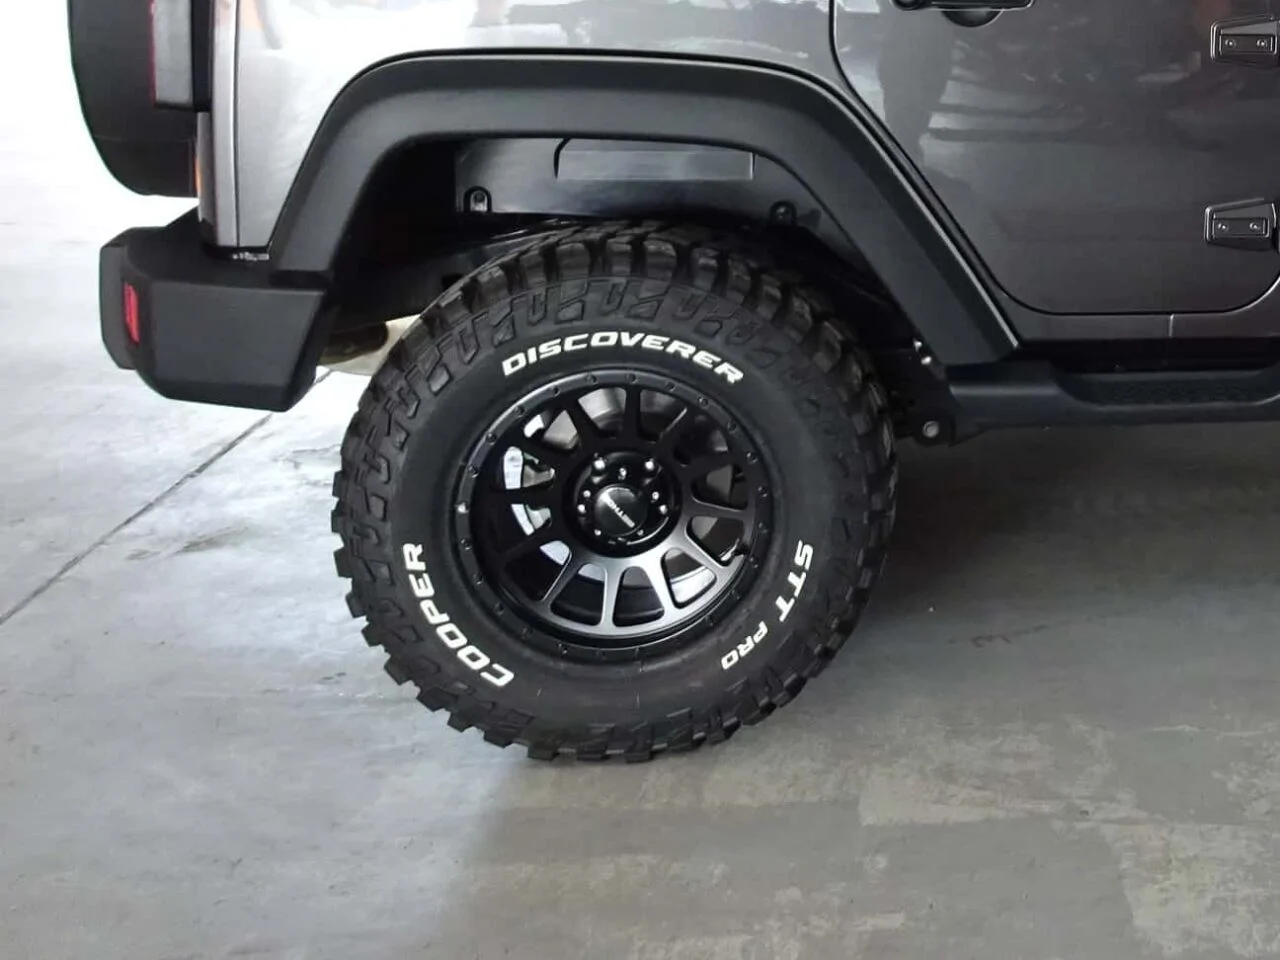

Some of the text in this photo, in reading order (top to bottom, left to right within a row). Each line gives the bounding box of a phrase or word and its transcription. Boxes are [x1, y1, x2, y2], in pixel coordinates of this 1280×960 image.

[502, 331, 744, 384] DISCOVERER
[403, 543, 514, 687] COOPER
[721, 540, 814, 670] STT PRO
